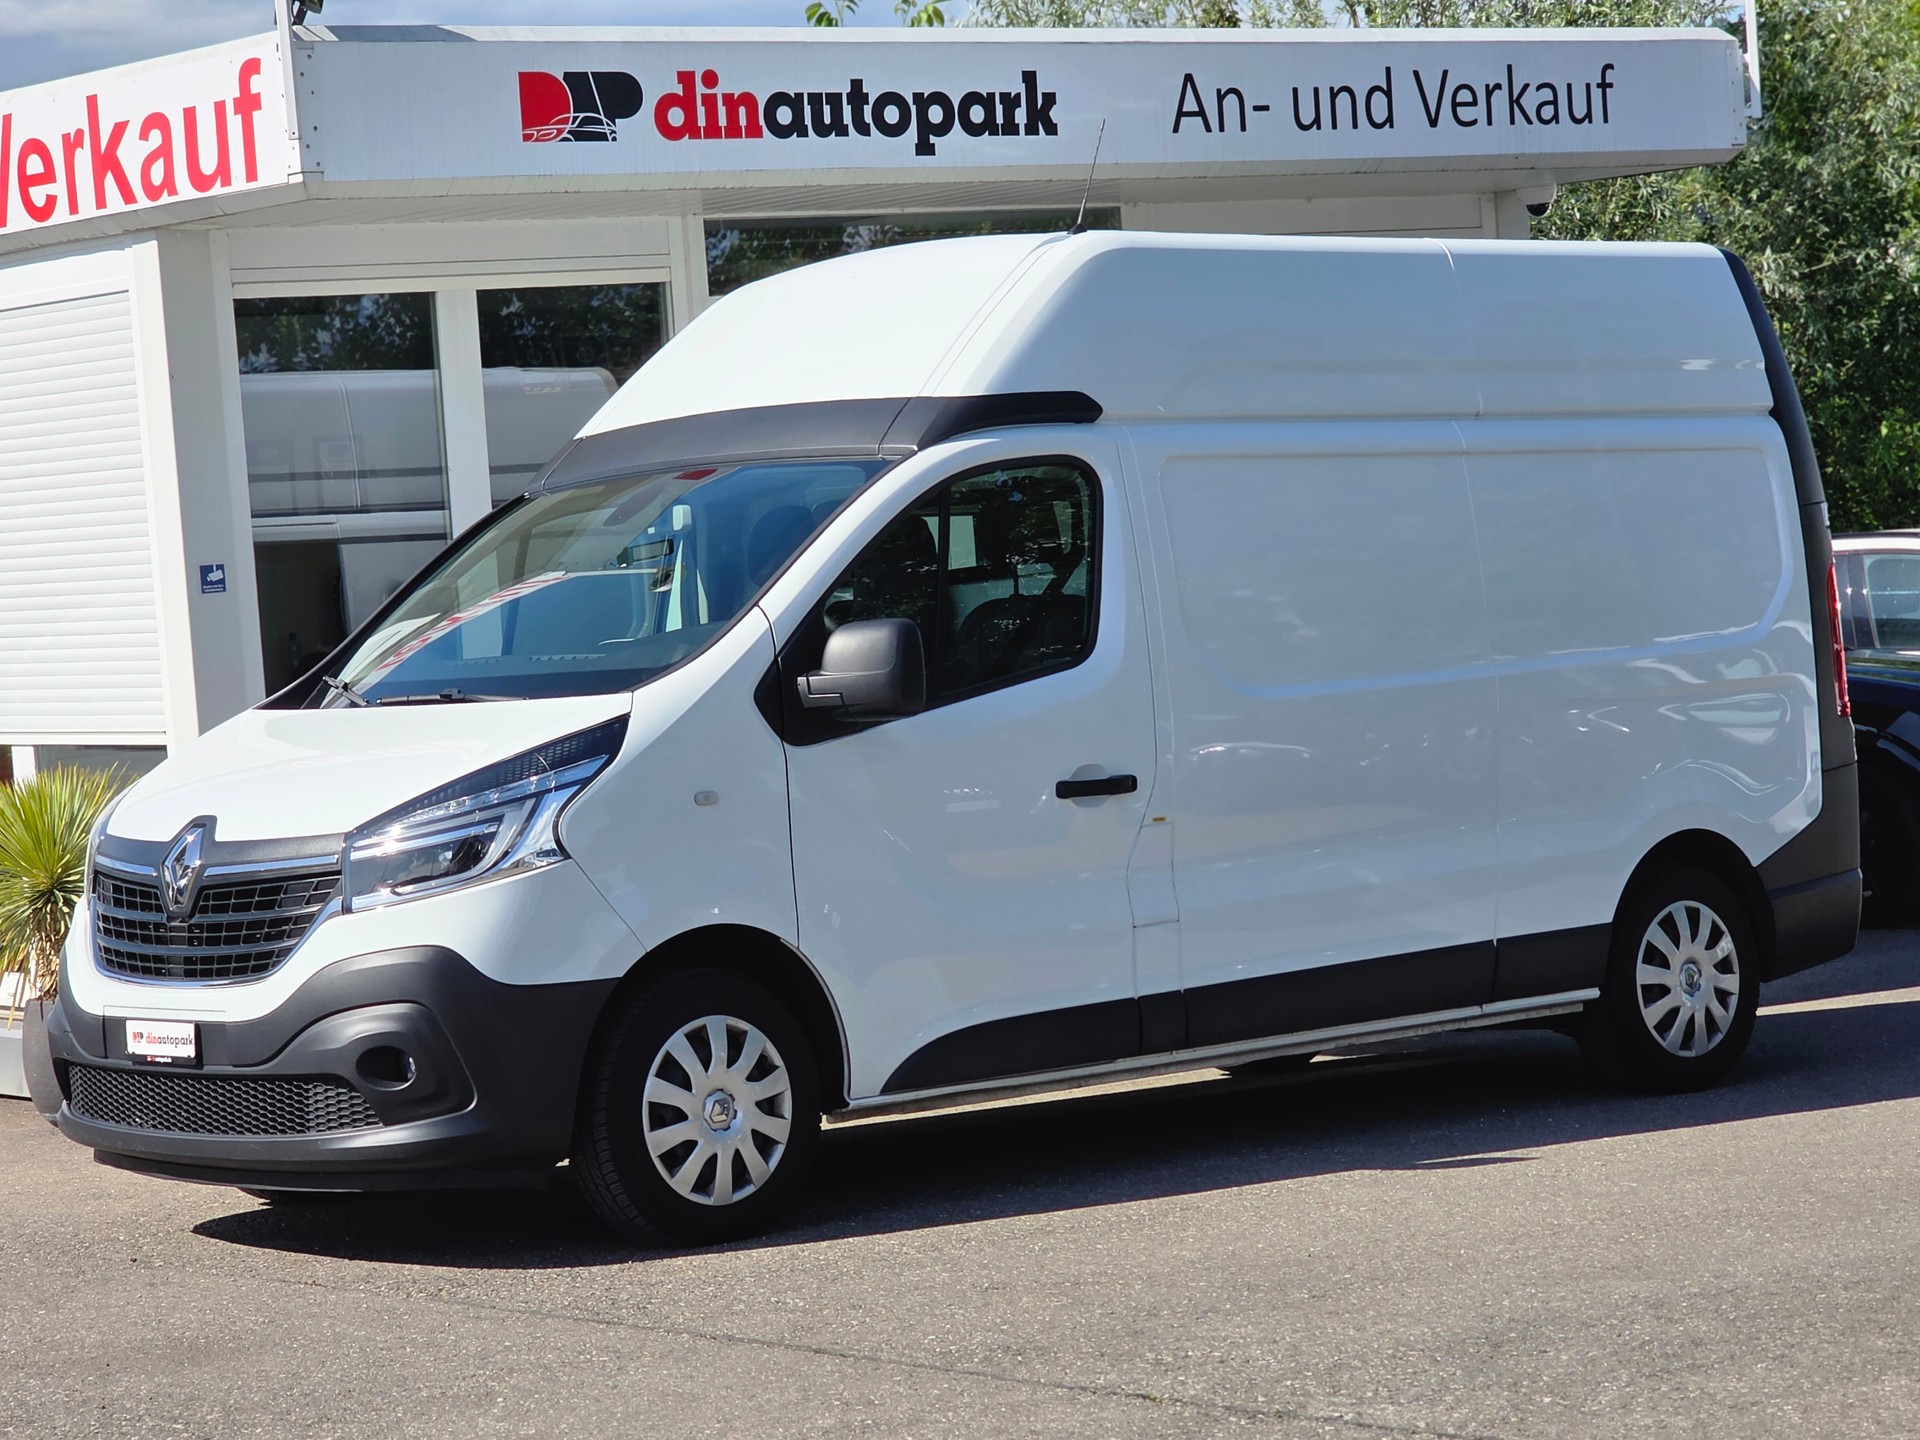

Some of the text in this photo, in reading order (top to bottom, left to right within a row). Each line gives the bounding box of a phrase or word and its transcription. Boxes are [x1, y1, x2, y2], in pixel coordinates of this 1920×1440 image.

[654, 69, 1059, 156] dinautopark
[1172, 63, 1615, 134] An- und Verkauf
[146, 1031, 193, 1049] dinautopark
